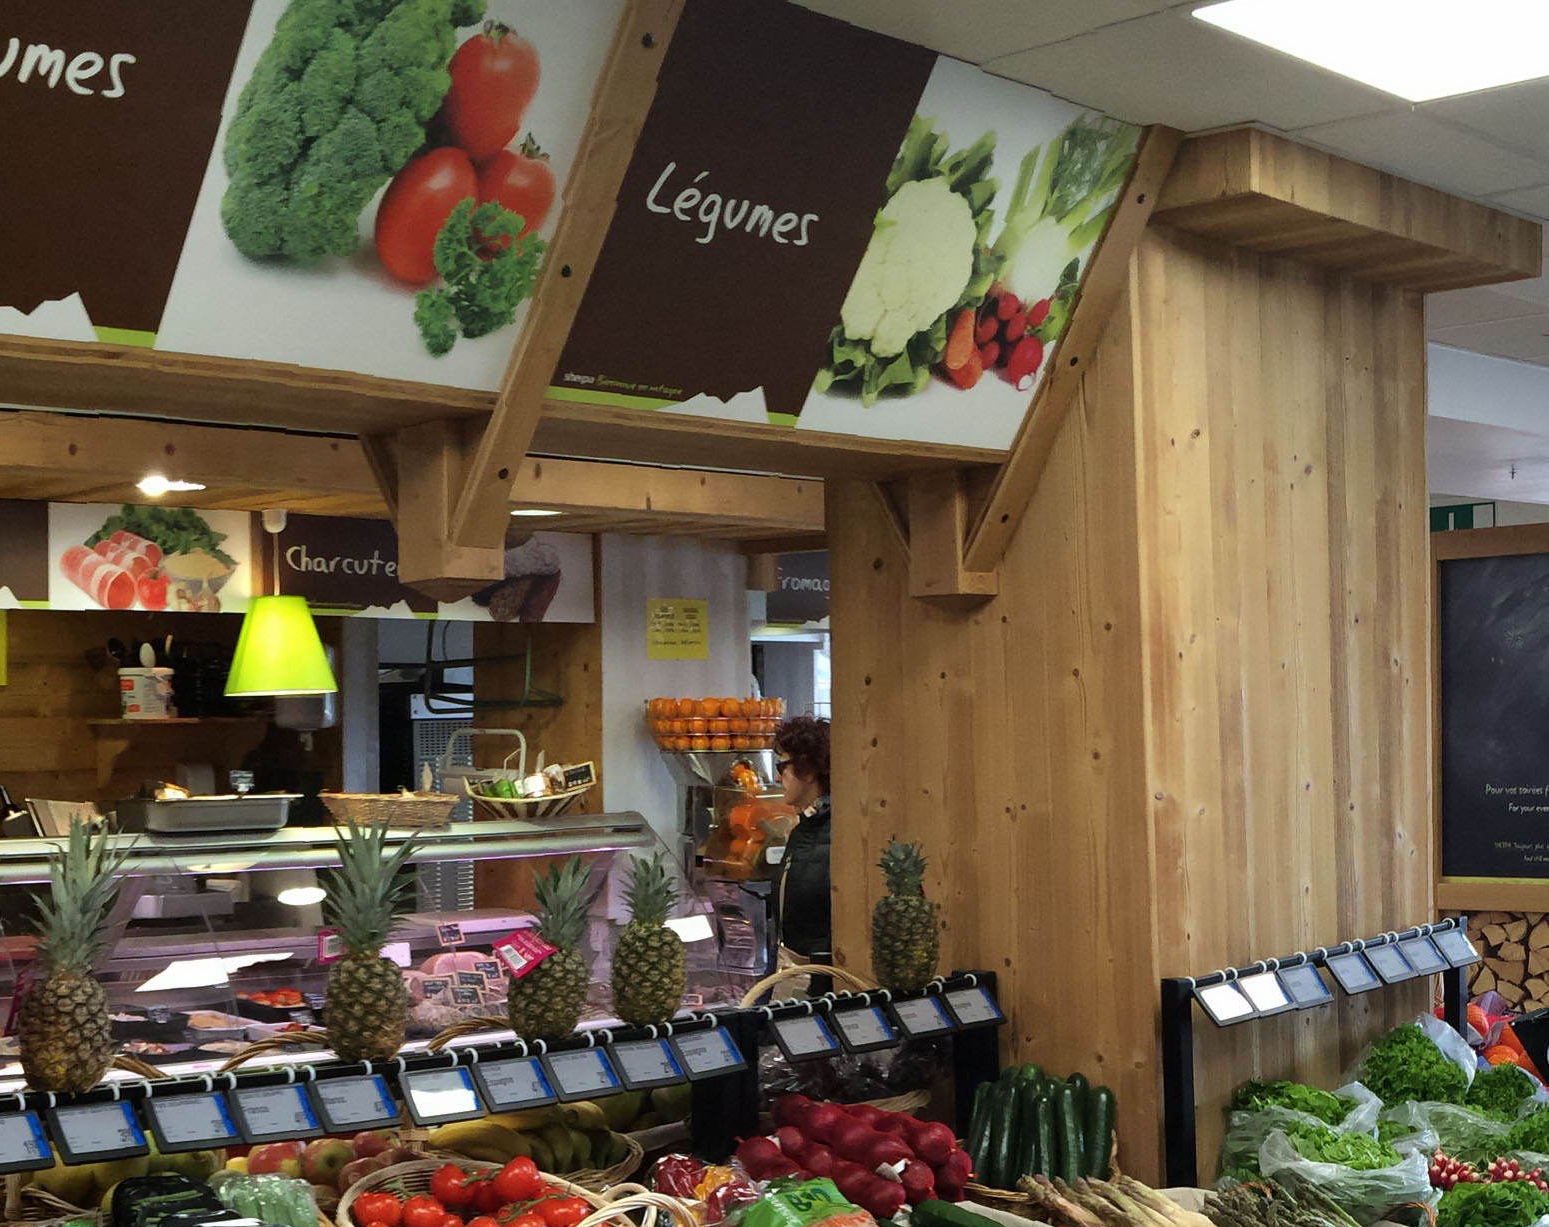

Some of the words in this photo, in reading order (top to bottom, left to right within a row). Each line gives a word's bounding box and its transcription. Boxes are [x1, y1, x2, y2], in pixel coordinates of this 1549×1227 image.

[646, 162, 819, 245] Légumes
[286, 545, 399, 577] Charcute
[1485, 783, 1503, 795] Pour
[1508, 802, 1519, 812] For
[1520, 805, 1535, 815] your
